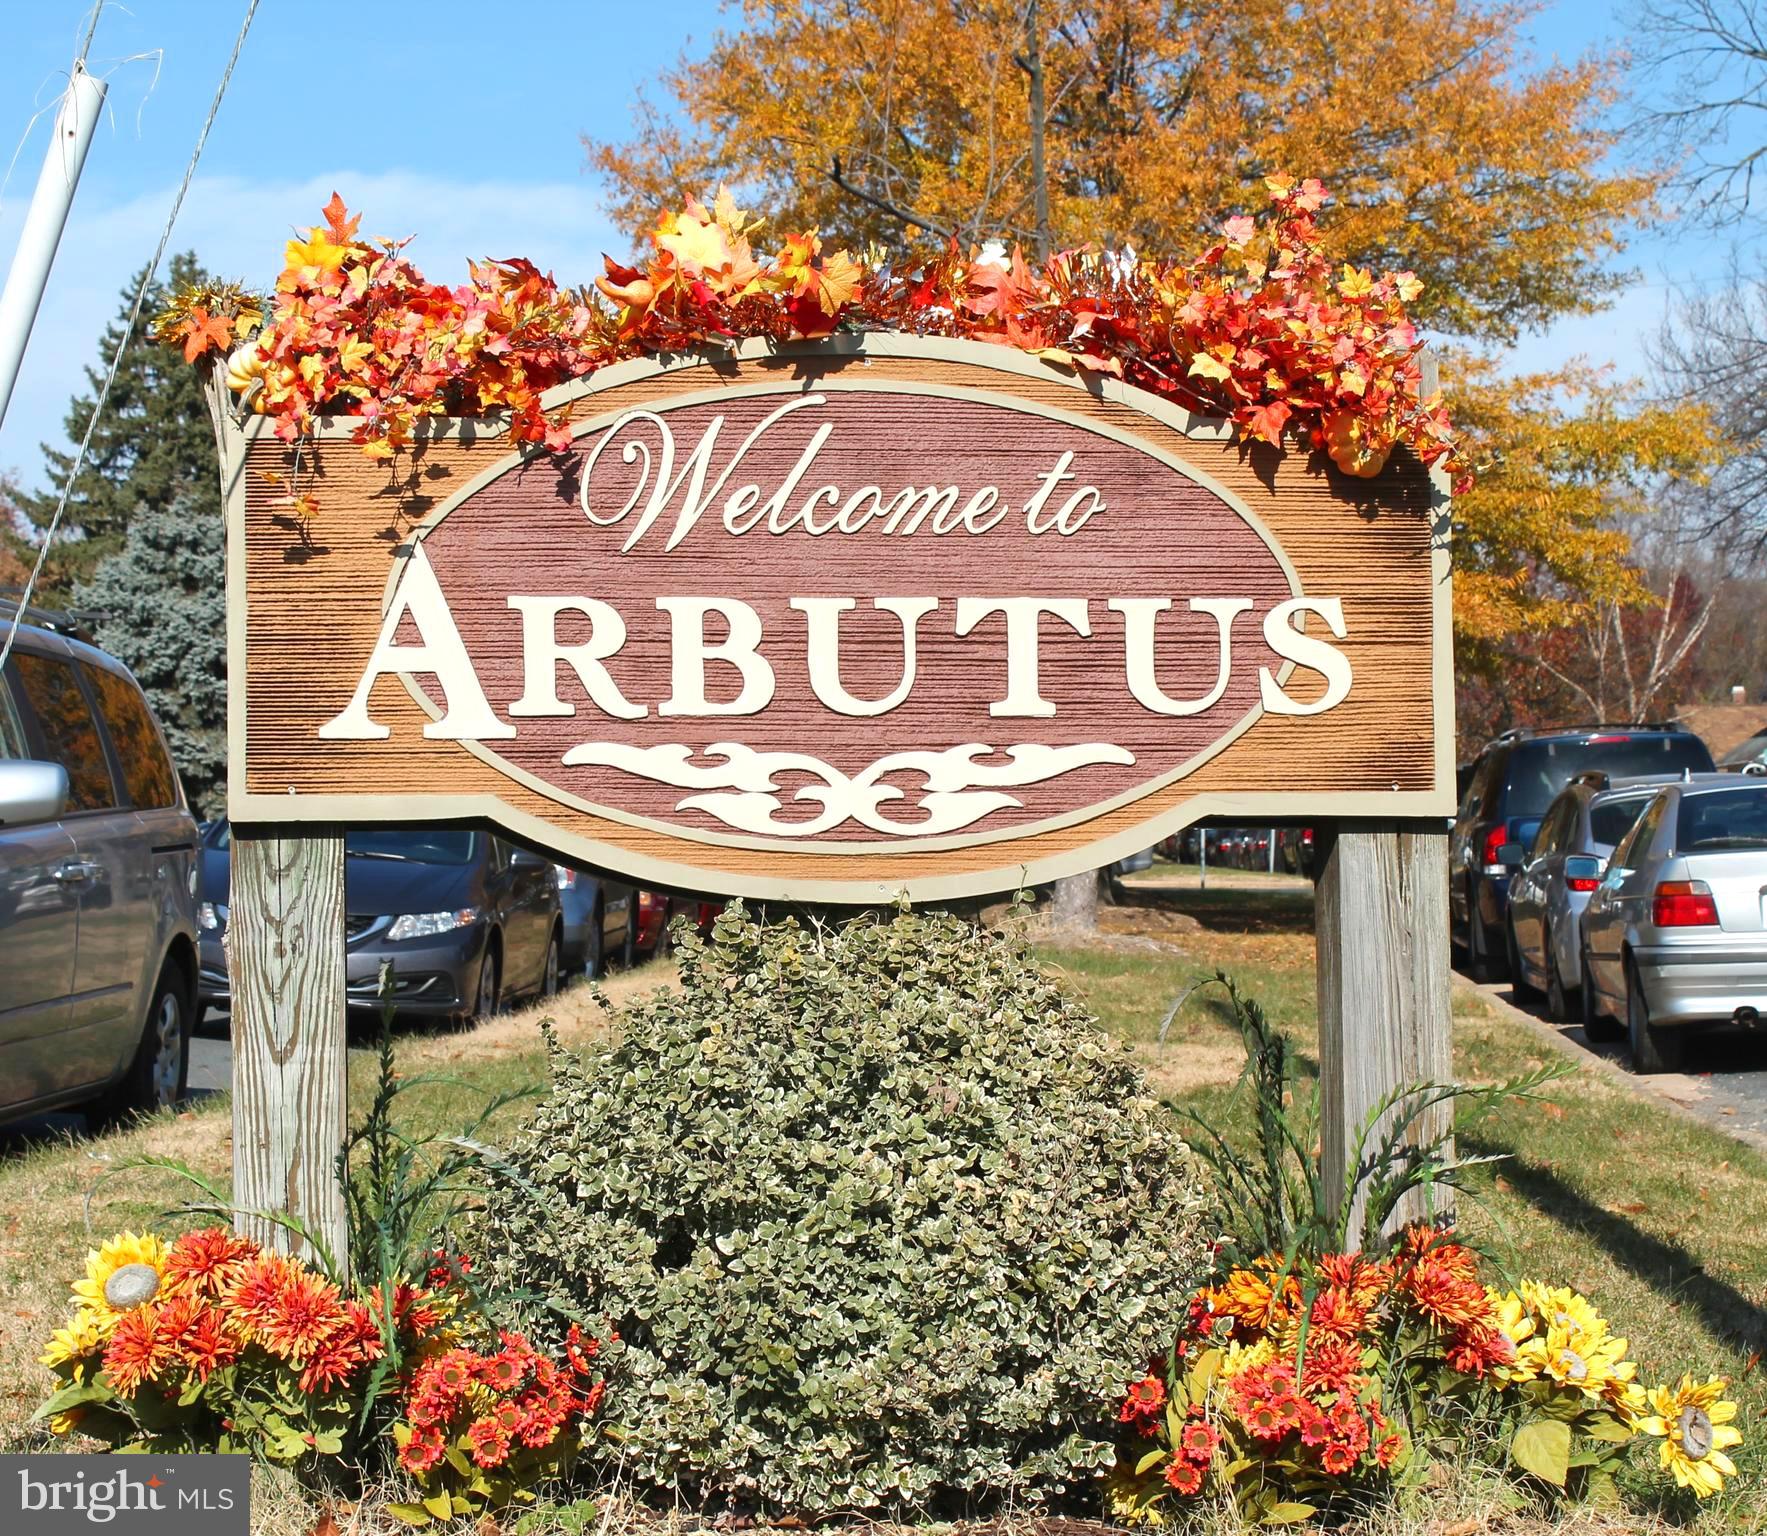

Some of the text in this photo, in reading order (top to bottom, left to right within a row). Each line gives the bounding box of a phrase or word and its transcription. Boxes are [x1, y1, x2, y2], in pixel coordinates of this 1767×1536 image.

[580, 394, 1107, 554] Welcome to
[317, 539, 1354, 741] ARBUTUS
